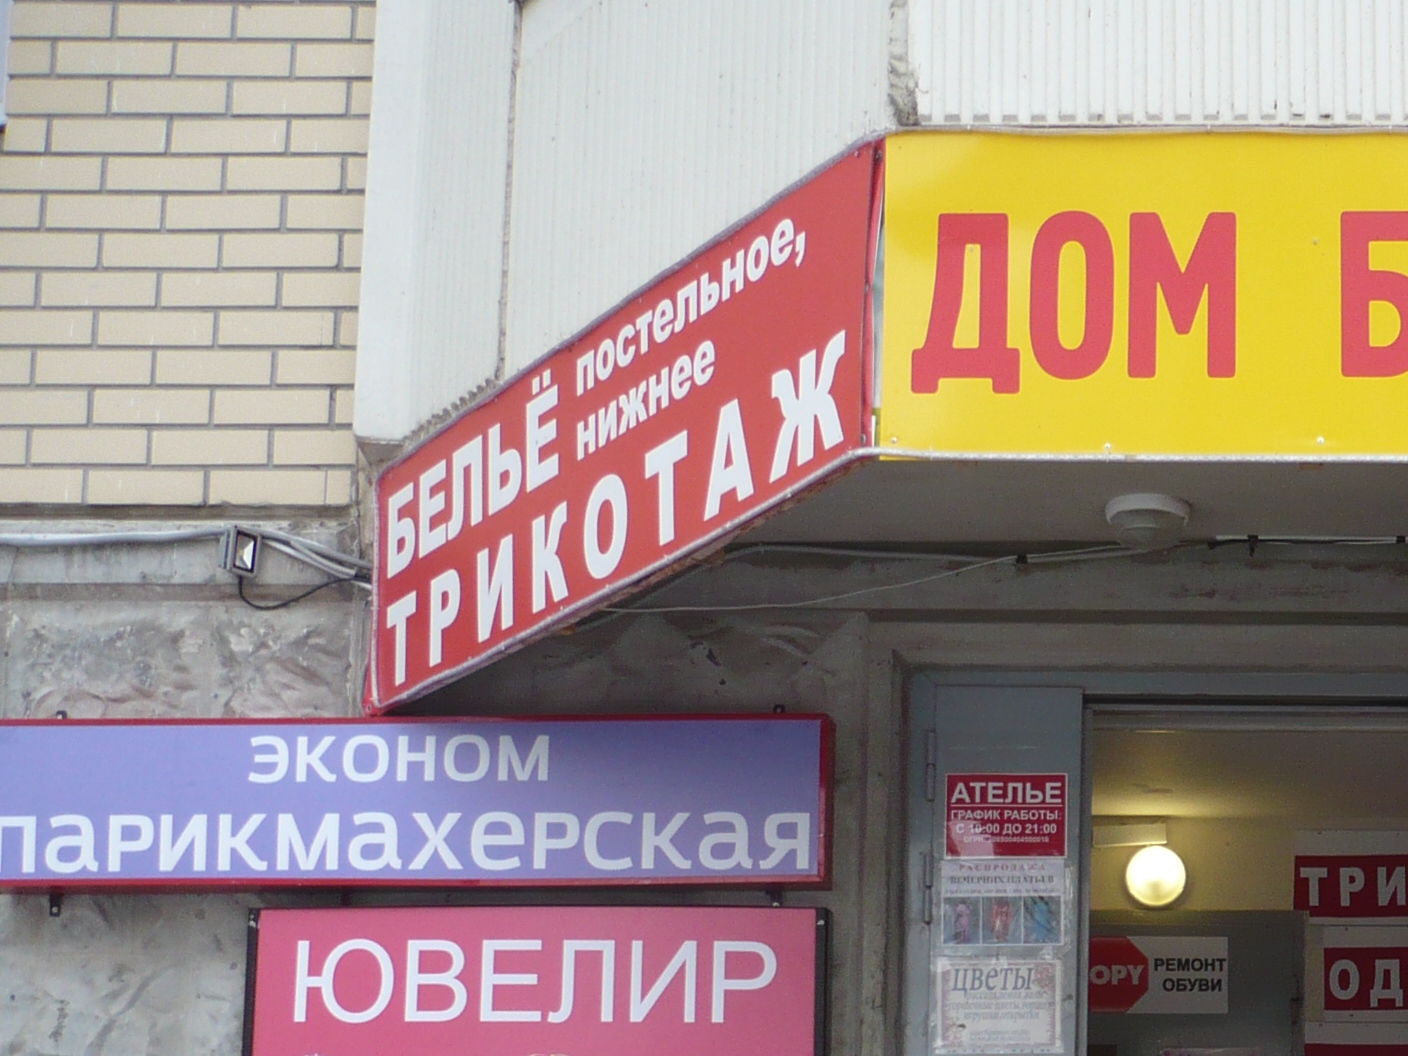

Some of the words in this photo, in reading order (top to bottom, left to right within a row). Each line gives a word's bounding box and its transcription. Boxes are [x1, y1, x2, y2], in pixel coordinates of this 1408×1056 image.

[577, 218, 806, 396] постельное,
[911, 211, 1237, 394] ДОМ
[577, 340, 716, 461] нижнее
[387, 370, 559, 579] БЕЛЬЁ
[387, 331, 846, 686] ТРИКОТАЖ
[951, 782, 1062, 804] АТЕЛЬЕ
[951, 809, 1001, 820] ГРАФИК
[1004, 809, 1062, 820] РАБОТЫ:
[956, 823, 965, 834] С
[1003, 823, 1022, 836] ДО
[1025, 823, 1057, 834] 21:00
[959, 863, 1046, 873] РАСПРОДАЖА
[950, 875, 1005, 885] ВЕЧЕРНИХ
[1154, 958, 1226, 973] РЕМОНТ
[294, 939, 778, 1024] ЮВЕЛИР
[1162, 978, 1222, 992] ОБУВИ
